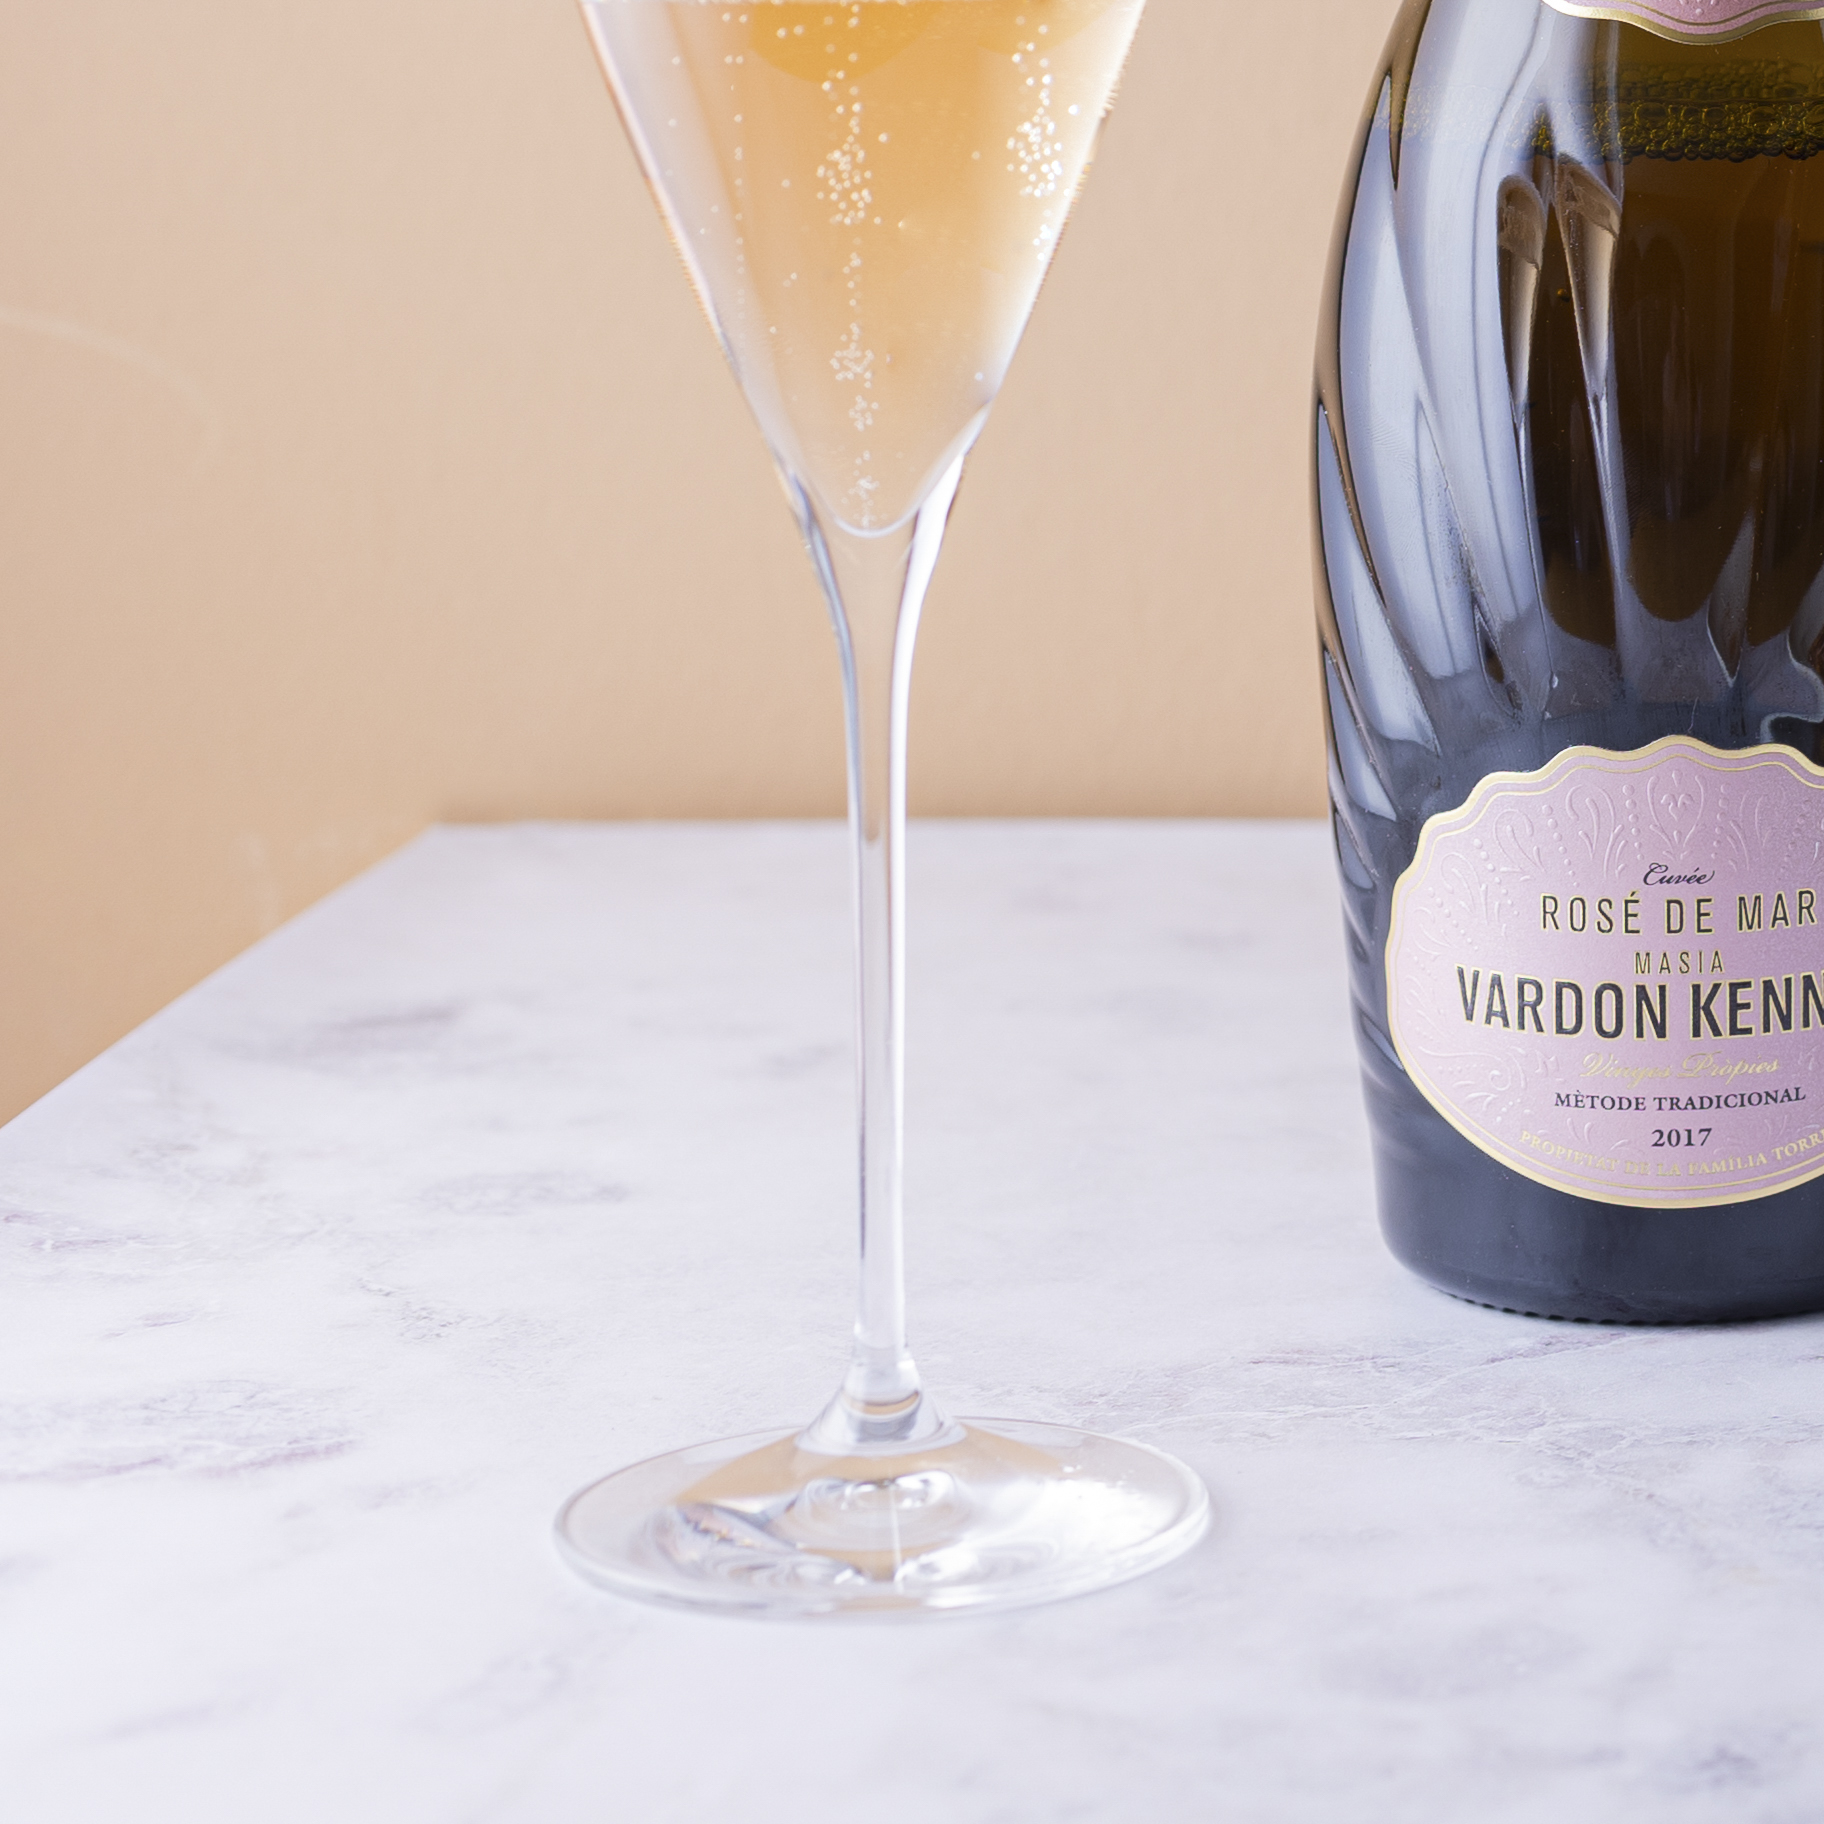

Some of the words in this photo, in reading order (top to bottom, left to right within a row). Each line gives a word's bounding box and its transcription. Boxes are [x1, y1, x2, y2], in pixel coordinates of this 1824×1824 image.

[1642, 862, 1715, 886] Cuvée
[1540, 890, 1642, 935] ROSÉ
[1664, 897, 1715, 935] DE
[1736, 888, 1818, 932] MAR
[1633, 949, 1725, 975] MASIA
[1455, 963, 1668, 1041] VARDON
[1580, 1052, 1673, 1090] Vinyes
[1677, 1050, 1780, 1085] Pròpies
[1554, 1090, 1647, 1111] MÈTODE
[1653, 1086, 1807, 1111] TRADICIONAL
[1518, 1129, 1620, 1173] PROPIETAT
[1625, 1160, 1651, 1176] DE
[1656, 1160, 1682, 1176] LA
[1688, 1152, 1769, 1176] FAMÍLIA
[1651, 1127, 1713, 1148] 2017
